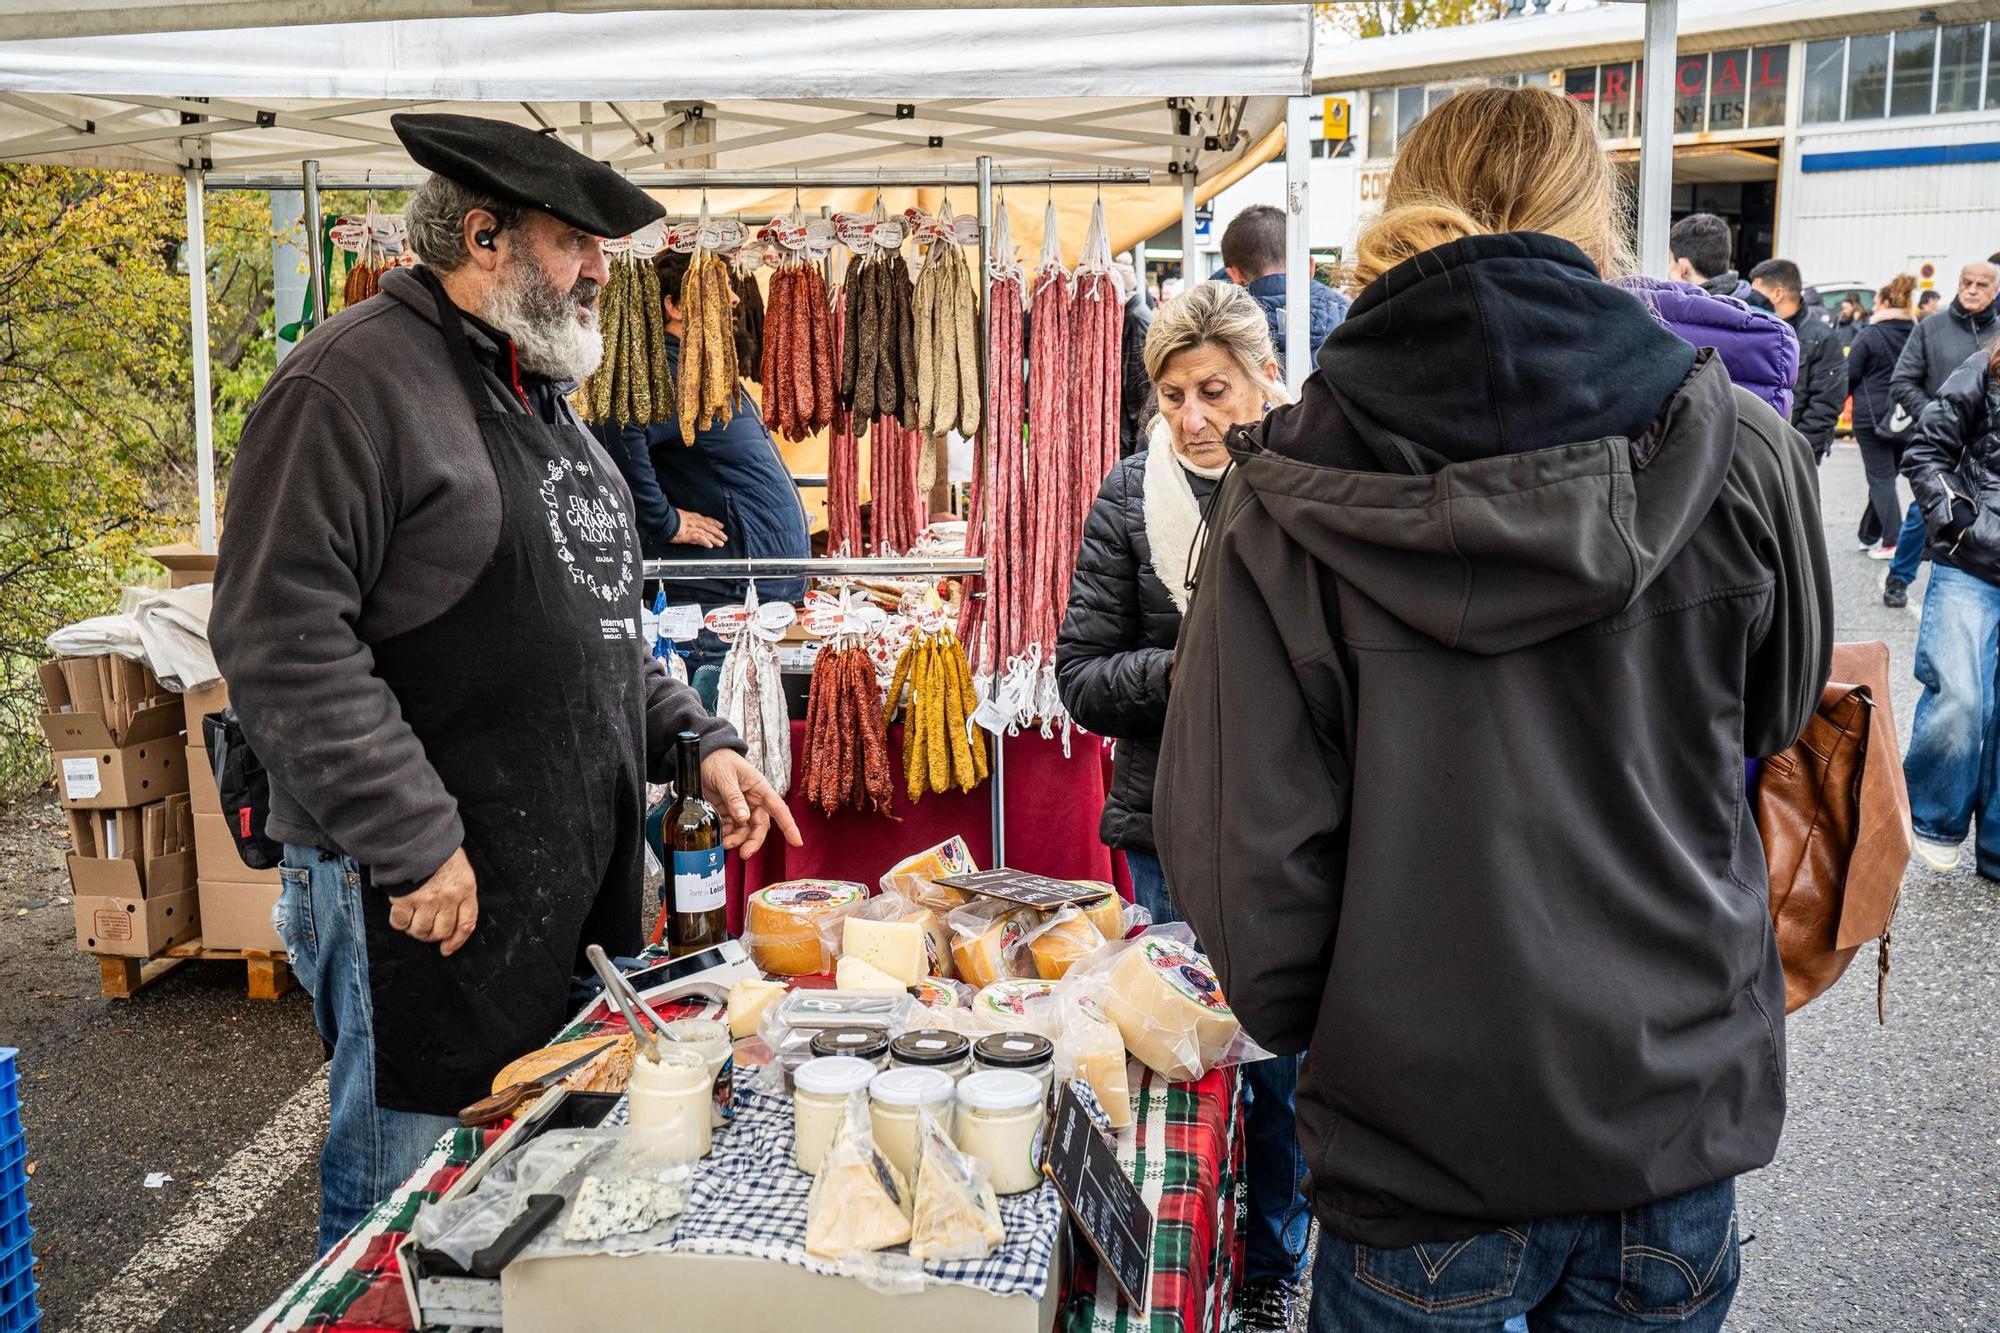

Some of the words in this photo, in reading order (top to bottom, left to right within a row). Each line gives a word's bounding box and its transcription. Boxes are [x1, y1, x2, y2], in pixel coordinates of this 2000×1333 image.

[1605, 53, 1783, 100] RCAL
[842, 230, 870, 239] Cabanas
[711, 620, 740, 628] Cabanas
